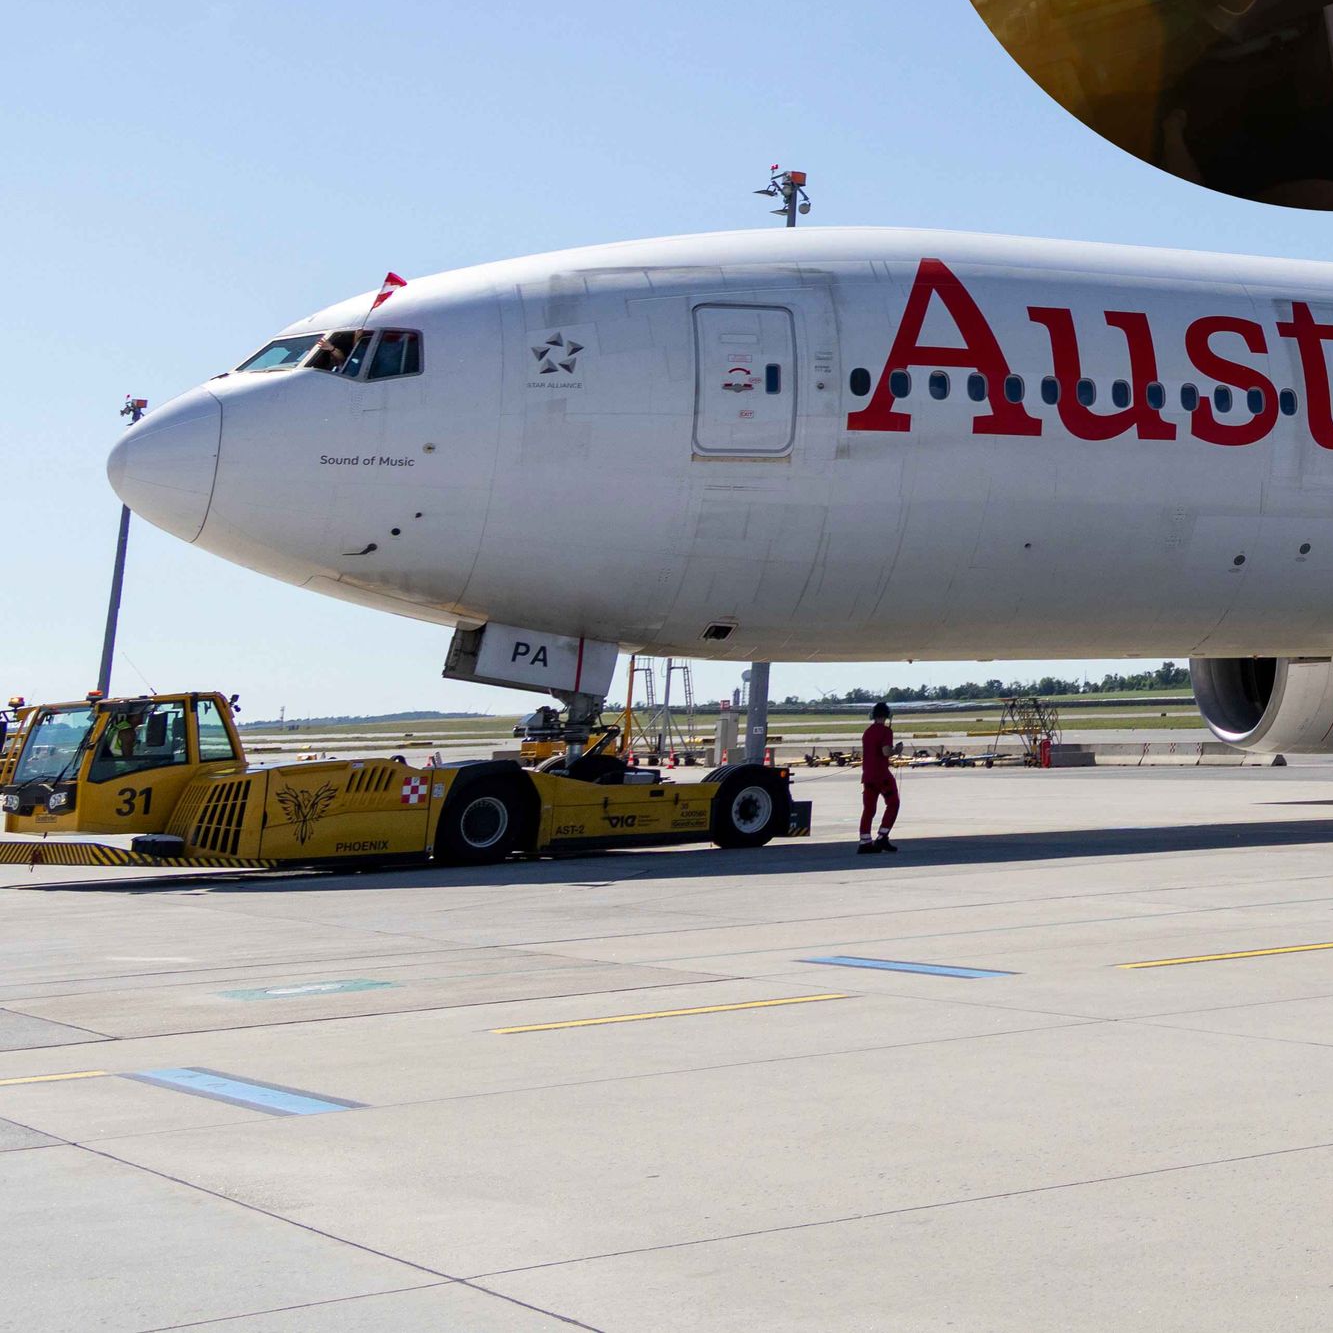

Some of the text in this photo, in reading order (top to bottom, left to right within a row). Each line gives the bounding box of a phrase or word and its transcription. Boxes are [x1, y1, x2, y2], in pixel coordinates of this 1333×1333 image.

[320, 455, 415, 467] Sound of Music
[511, 641, 549, 668] PA
[116, 787, 153, 816] 31
[555, 825, 585, 835] AST-2
[335, 840, 389, 852] PHOENIX
